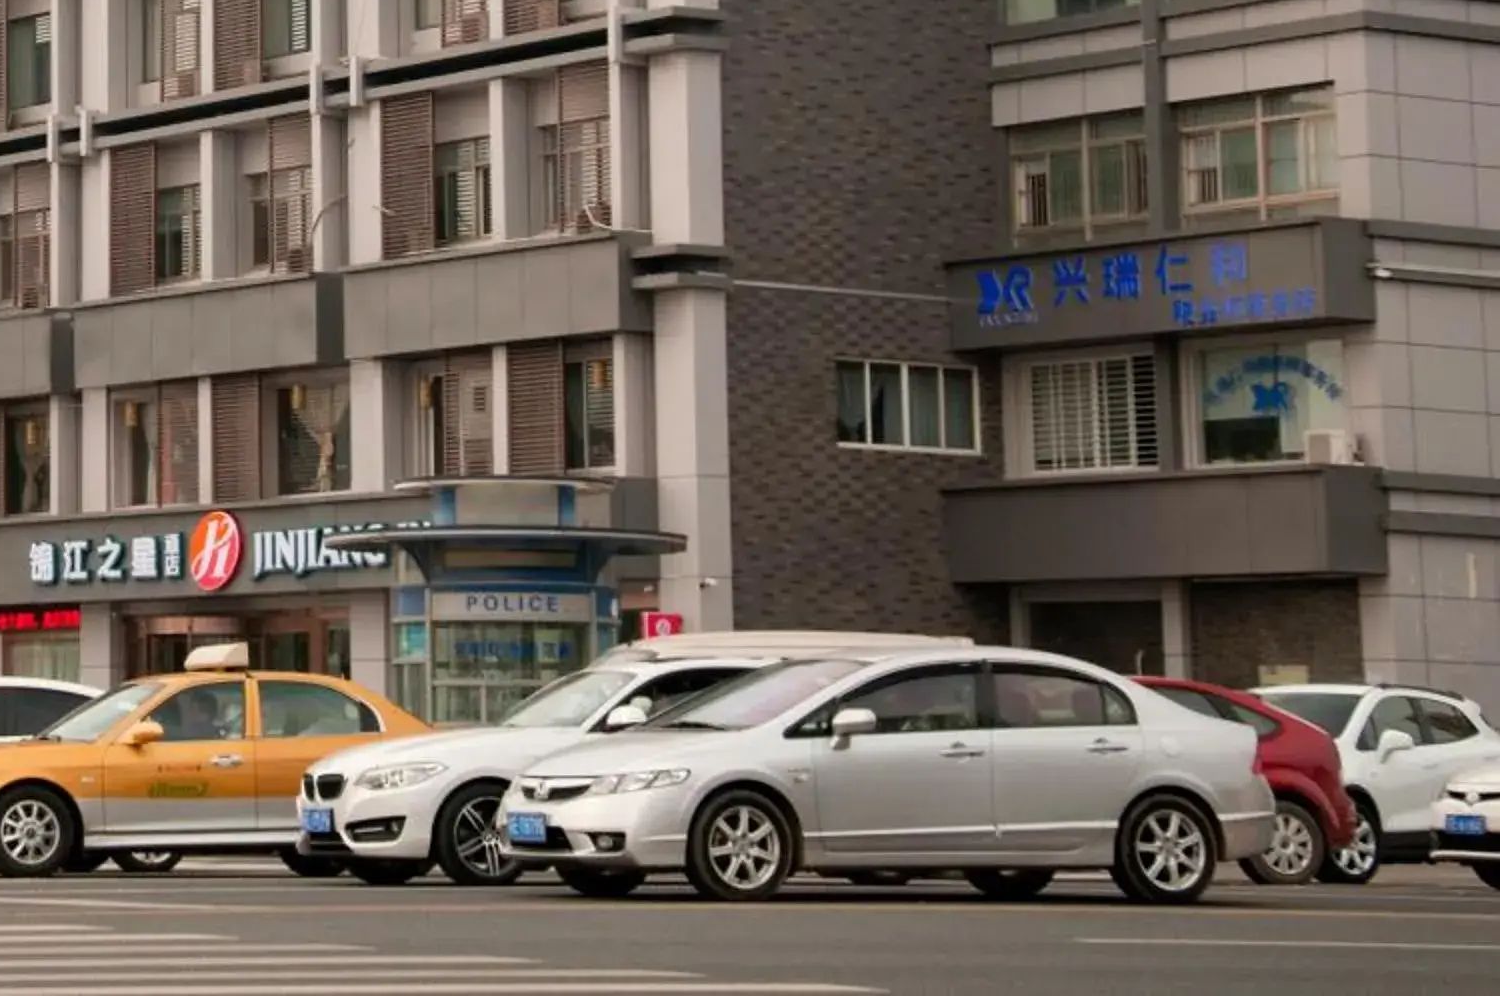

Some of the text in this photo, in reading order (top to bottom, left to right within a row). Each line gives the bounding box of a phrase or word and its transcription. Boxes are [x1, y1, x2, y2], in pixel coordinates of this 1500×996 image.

[1053, 239, 1248, 307] 兴瑞仁和
[29, 535, 158, 584] 锦江之星
[466, 594, 560, 613] POLICE
